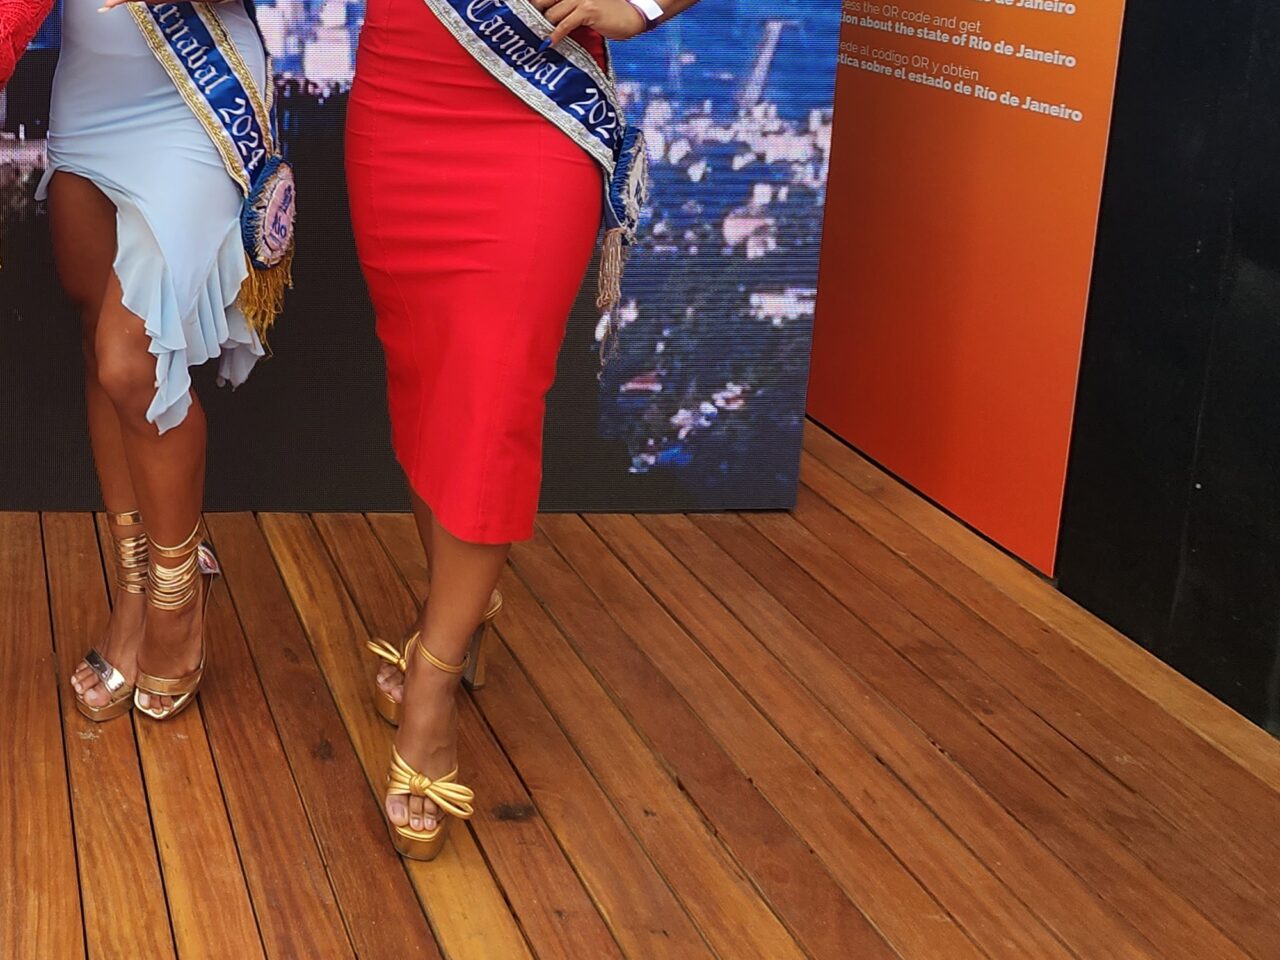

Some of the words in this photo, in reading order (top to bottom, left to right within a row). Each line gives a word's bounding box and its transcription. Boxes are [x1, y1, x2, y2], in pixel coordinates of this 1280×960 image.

[859, 16, 893, 32] about
[894, 21, 915, 36] the
[916, 27, 950, 43] state
[951, 34, 967, 46] of
[969, 35, 992, 51] Rio
[994, 40, 1014, 55] de
[1015, 44, 1076, 68] Janeiro
[863, 1, 880, 15] the
[882, 5, 899, 18] QR
[901, 9, 931, 24] code
[933, 15, 956, 29] and
[959, 19, 982, 33] get
[860, 44, 869, 56] al
[871, 48, 909, 65] código
[911, 55, 929, 69] QR
[932, 61, 940, 75] y
[941, 63, 979, 81] obtén
[861, 60, 892, 76] sobre
[894, 68, 906, 80] el
[908, 72, 951, 90] estado
[954, 81, 972, 95] de
[999, 91, 1020, 107] de
[1021, 96, 1083, 121] Janeiro
[218, 97, 266, 171] 2024
